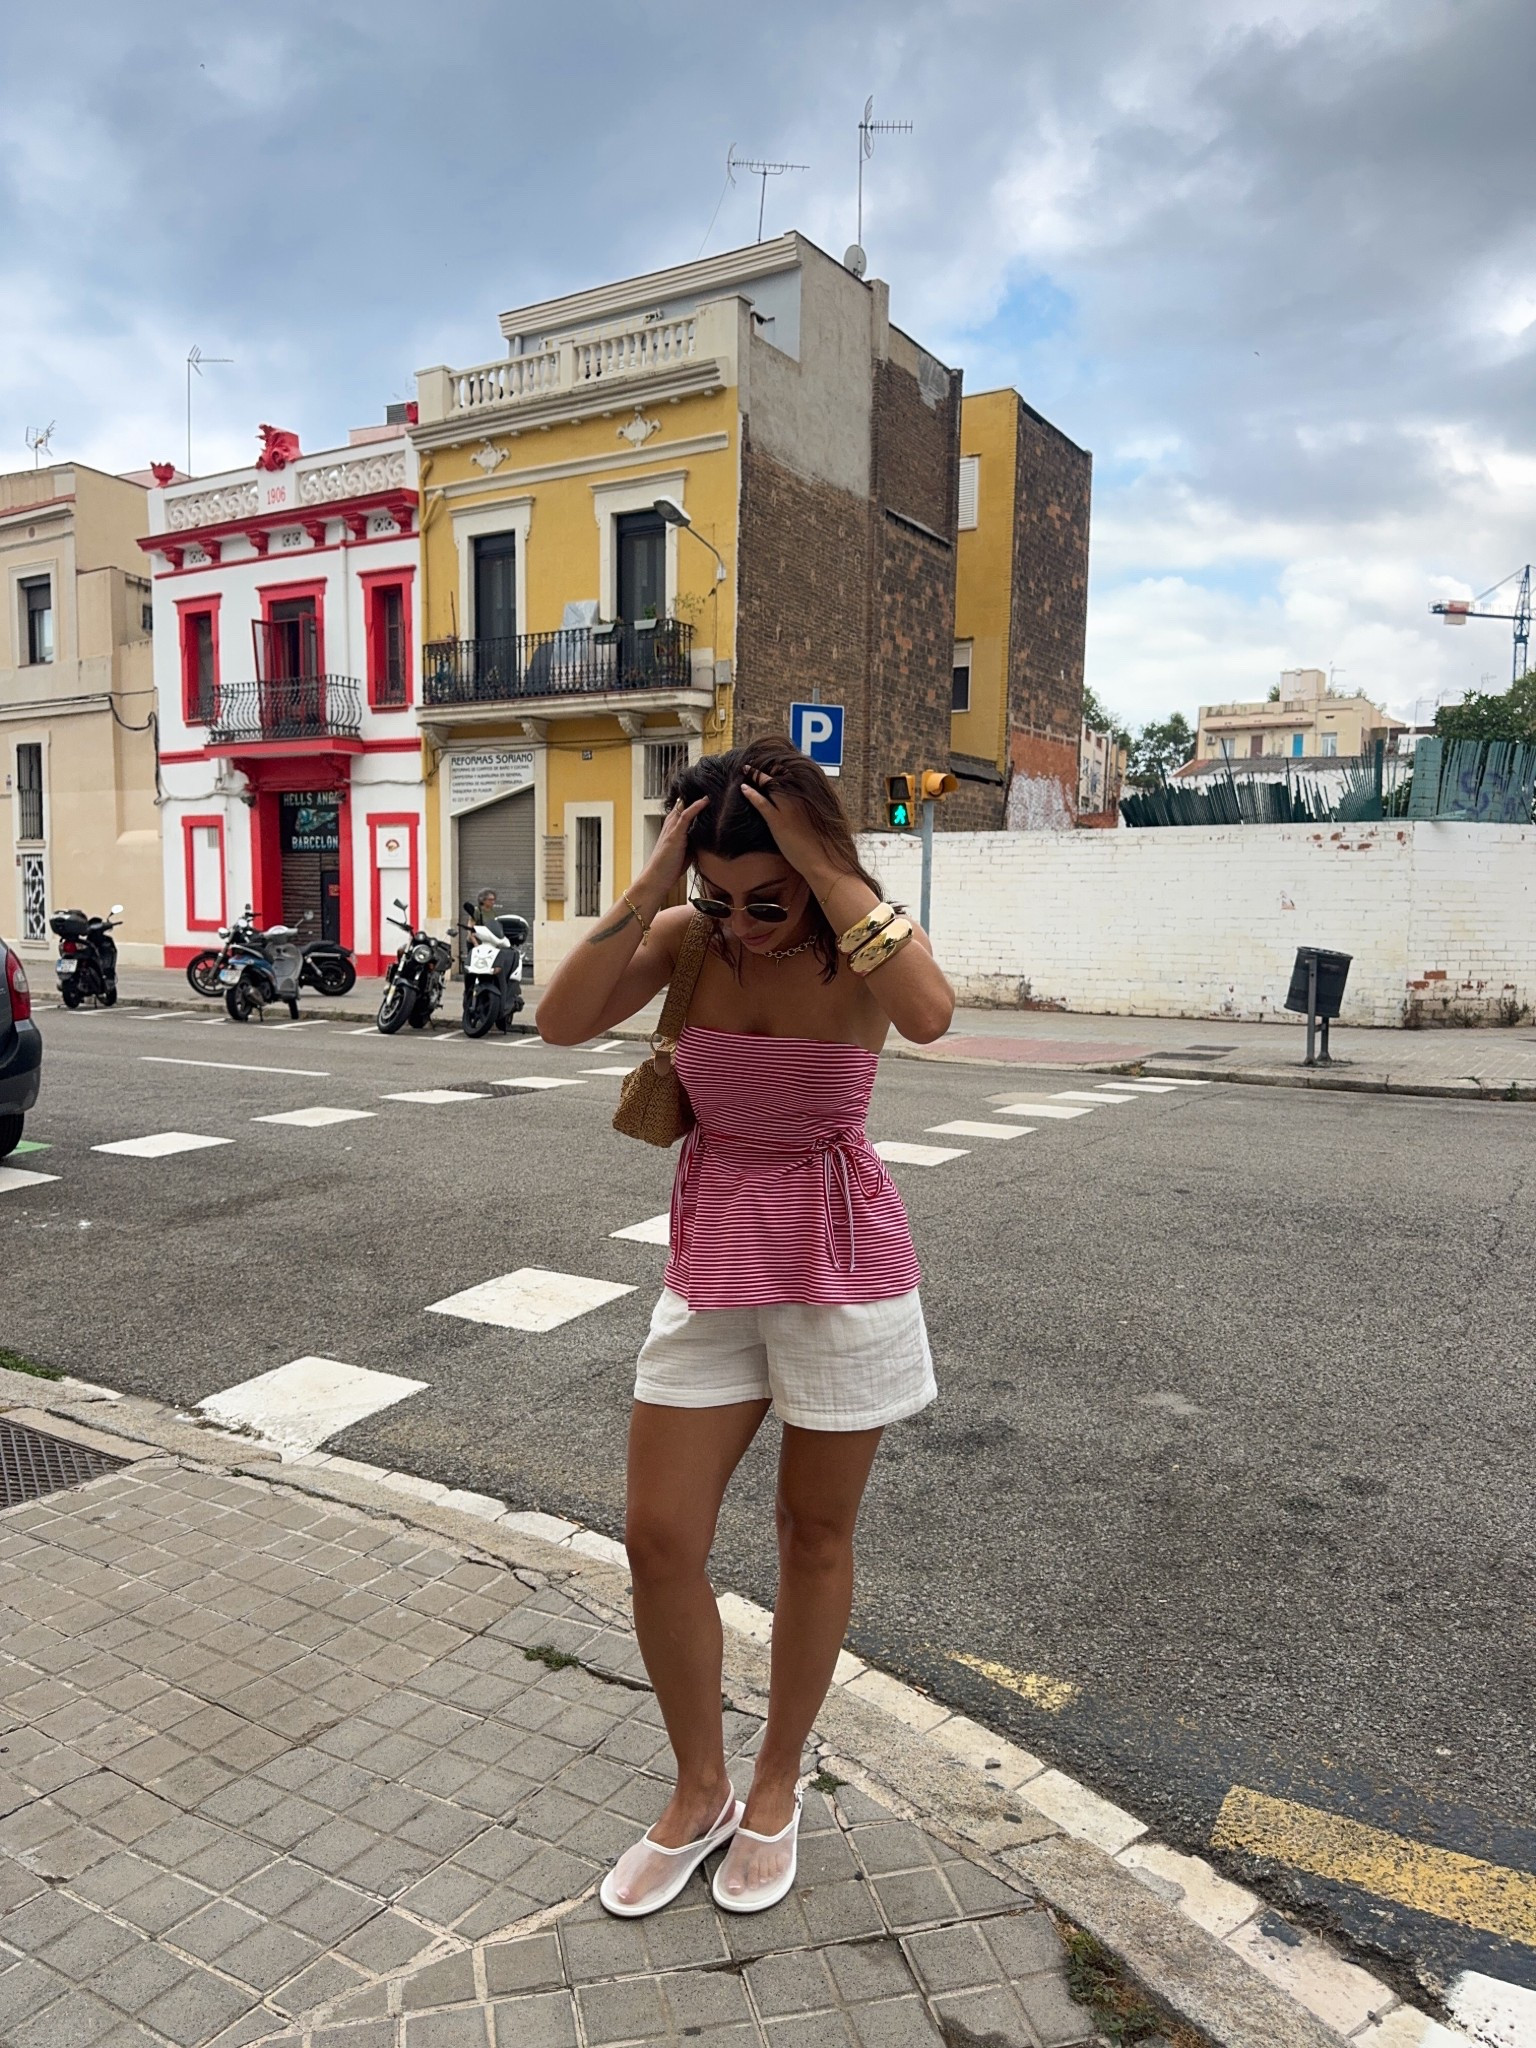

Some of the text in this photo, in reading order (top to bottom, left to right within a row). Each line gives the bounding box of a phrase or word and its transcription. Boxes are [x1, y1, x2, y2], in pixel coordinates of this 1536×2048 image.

[267, 485, 286, 505] 1906
[801, 710, 833, 757] P
[451, 752, 533, 766] REFORMAS SORIANO
[283, 792, 312, 806] HELLS
[291, 835, 339, 850] BARCELON
